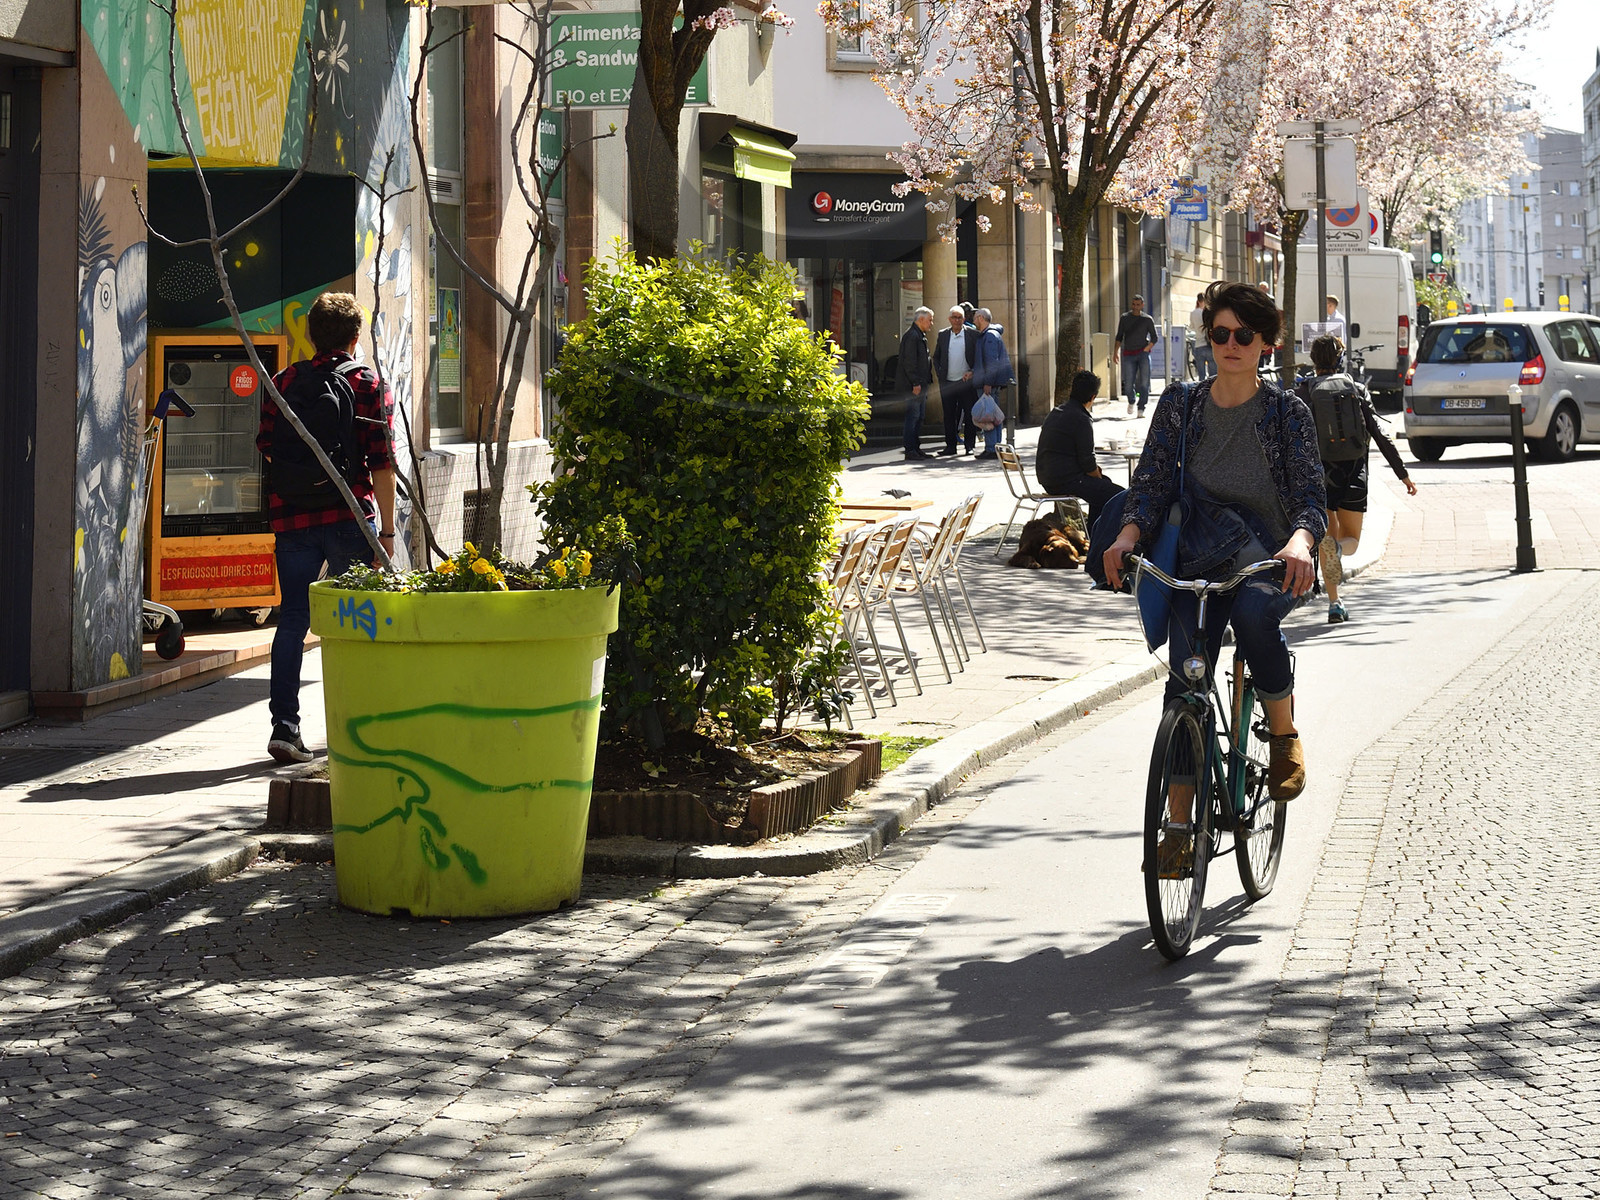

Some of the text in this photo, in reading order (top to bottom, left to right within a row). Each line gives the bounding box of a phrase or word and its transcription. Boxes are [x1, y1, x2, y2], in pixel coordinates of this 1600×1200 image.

[558, 25, 642, 42] Alimenta
[552, 49, 638, 68] & Sandw
[589, 89, 606, 103] et
[835, 199, 905, 215] MoneyGram
[1176, 204, 1201, 212] Photo
[833, 214, 890, 224] transfert d'argent
[235, 376, 253, 384] FRIGOS
[161, 563, 272, 581] LESFRIGOSSOLIDAIRES.COM
